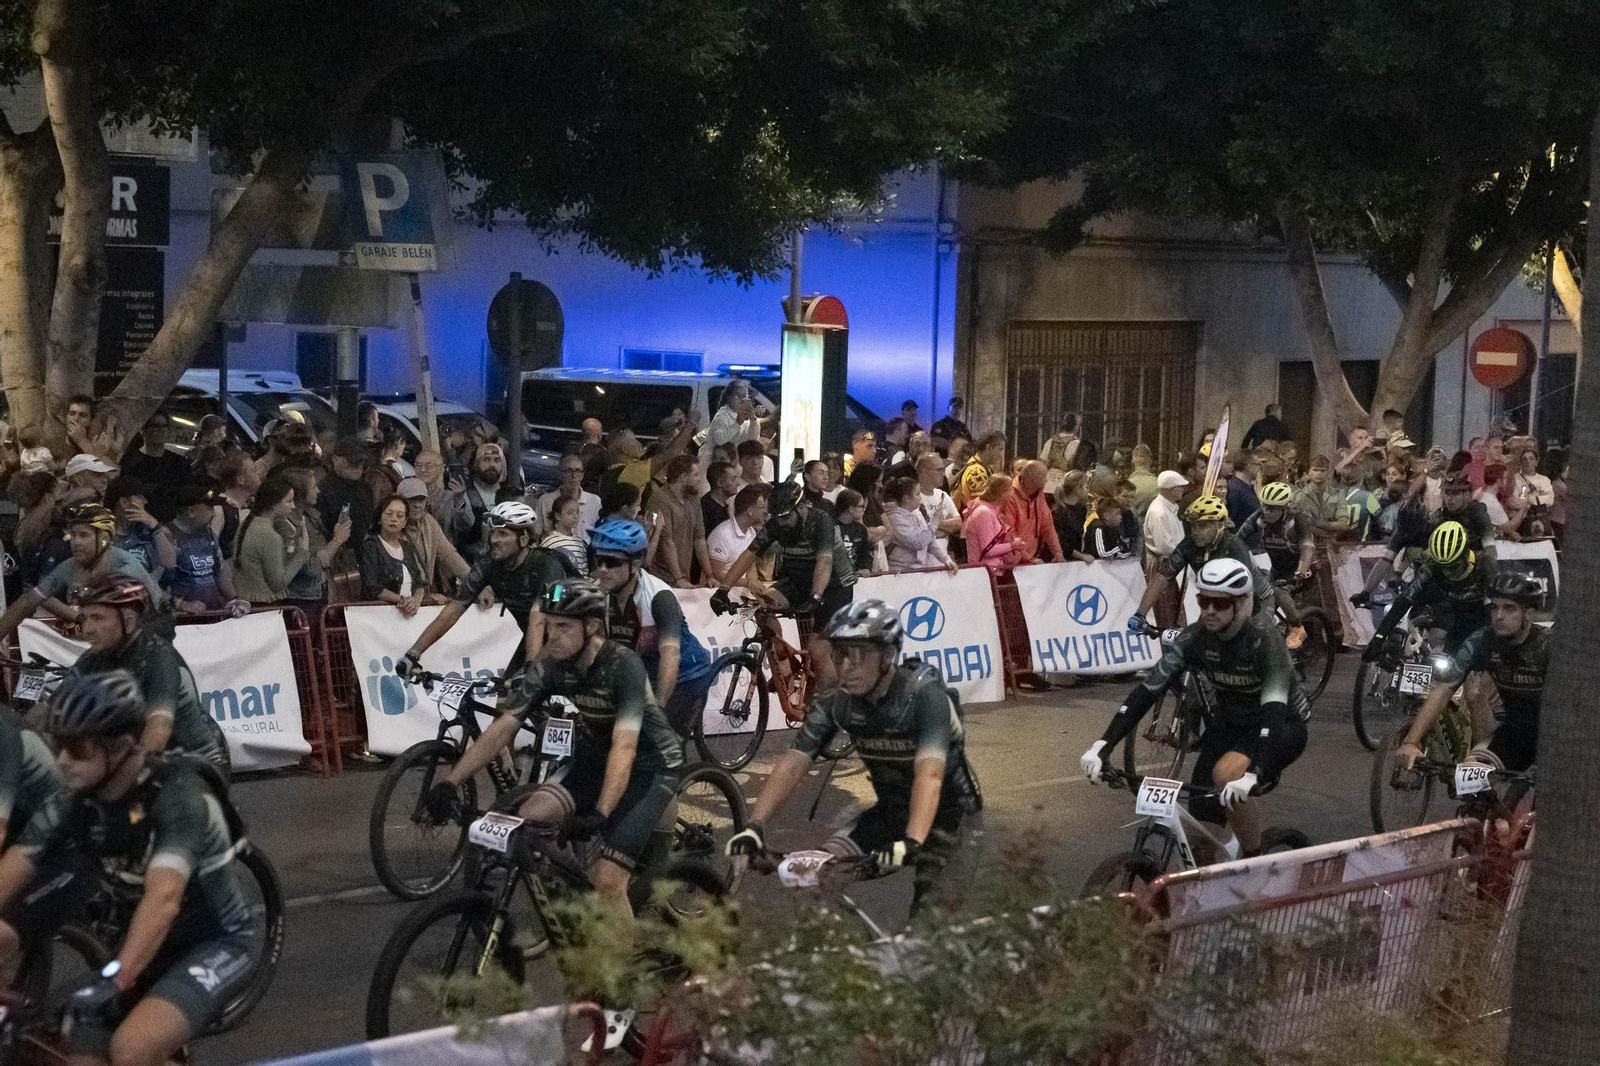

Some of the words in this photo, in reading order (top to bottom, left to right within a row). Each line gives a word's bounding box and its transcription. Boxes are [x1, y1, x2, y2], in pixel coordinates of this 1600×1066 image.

[357, 163, 409, 237] P
[361, 246, 398, 258] GARAJE
[402, 245, 432, 259] BELÉN
[1035, 629, 1153, 673] HYUNDAI
[241, 720, 284, 735] RURAL
[547, 728, 570, 745] 6847
[1146, 787, 1175, 805] 7521
